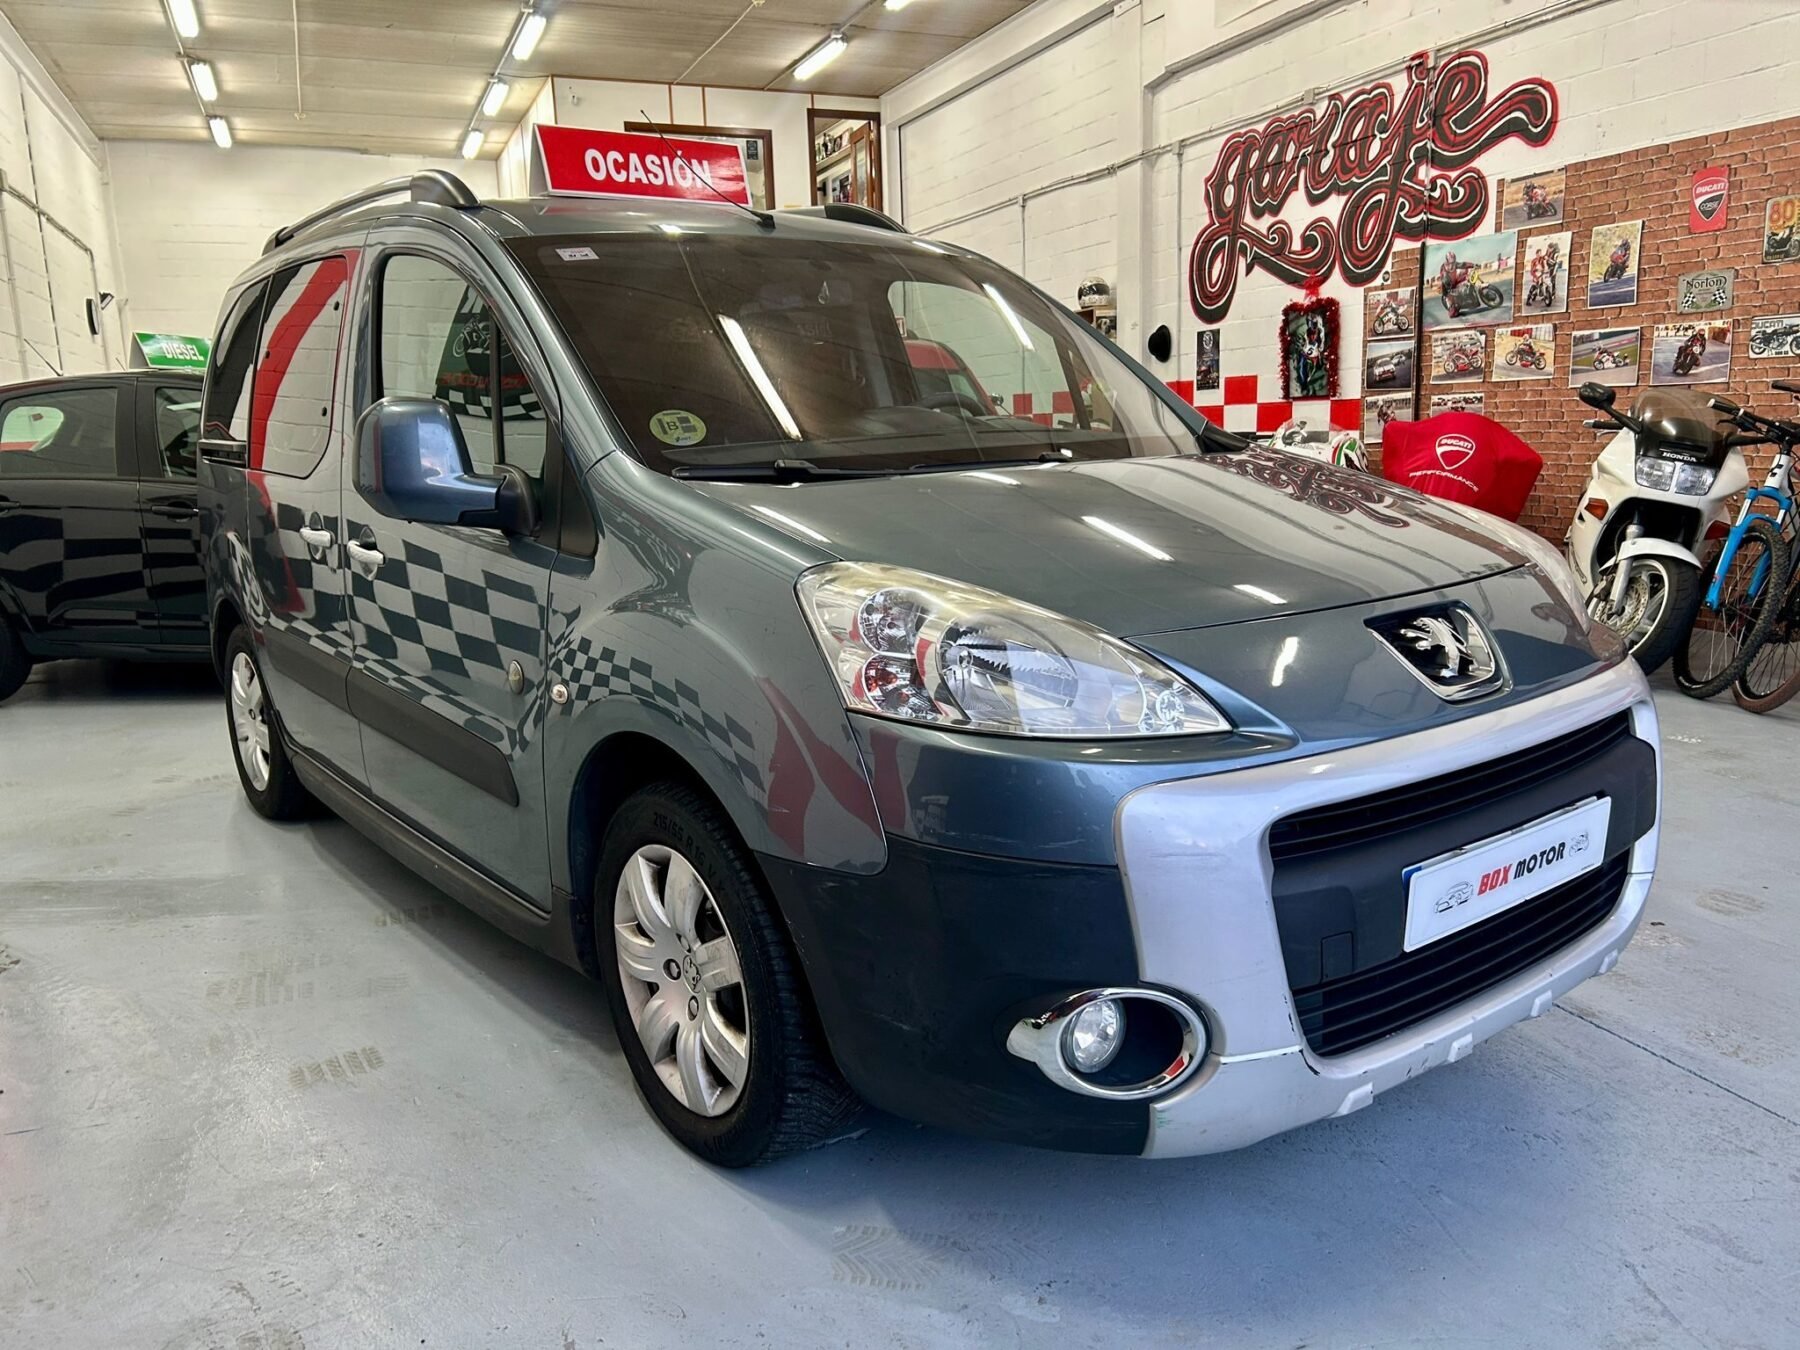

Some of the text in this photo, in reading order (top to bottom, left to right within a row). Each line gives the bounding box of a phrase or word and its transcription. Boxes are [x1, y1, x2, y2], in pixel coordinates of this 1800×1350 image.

[584, 148, 714, 189] OCASIÓN
[1189, 49, 1560, 325] garaje
[1696, 182, 1728, 194] DUCATI
[1683, 275, 1727, 289] Norton
[162, 342, 204, 361] DIESEL
[666, 421, 679, 431] B
[1440, 438, 1473, 449] DUCATI
[1662, 451, 1697, 462] HONDA
[1409, 469, 1480, 492] PERFORMANCE
[1477, 841, 1566, 896] BOX MOTOR
